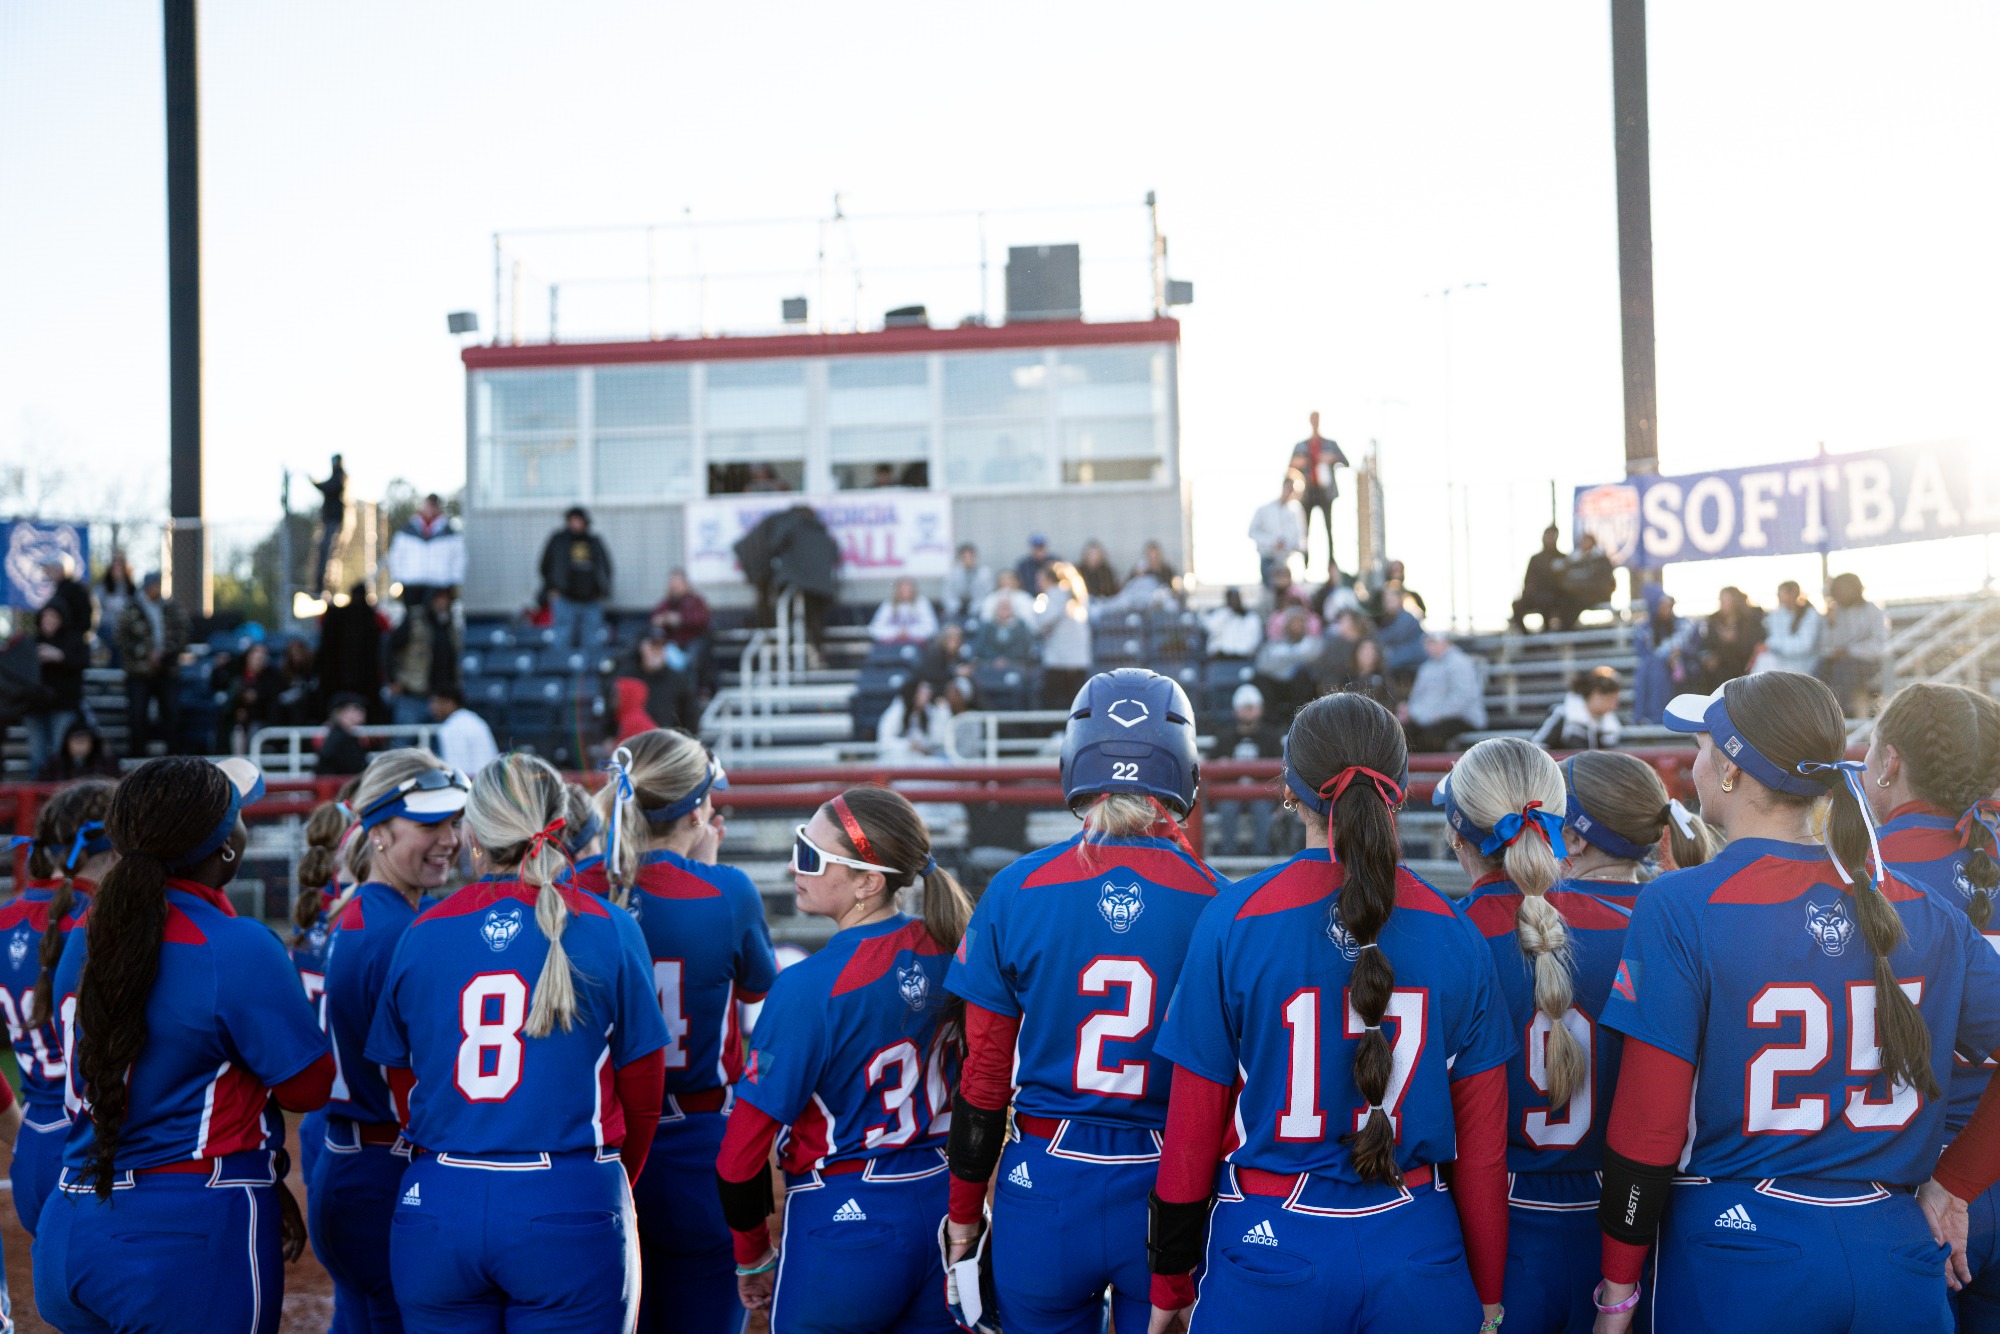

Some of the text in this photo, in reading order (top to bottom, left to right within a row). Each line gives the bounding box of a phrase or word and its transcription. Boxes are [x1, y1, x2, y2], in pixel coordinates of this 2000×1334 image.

[1112, 762, 1139, 781] 22
[453, 970, 530, 1104] 8
[1072, 954, 1158, 1100] 2
[1274, 986, 1429, 1145] 17
[1520, 1003, 1597, 1151] 9
[1742, 976, 1925, 1137] 25
[833, 1211, 867, 1222] adidas
[1243, 1234, 1278, 1246] adidas
[1715, 1217, 1757, 1231] adidas
